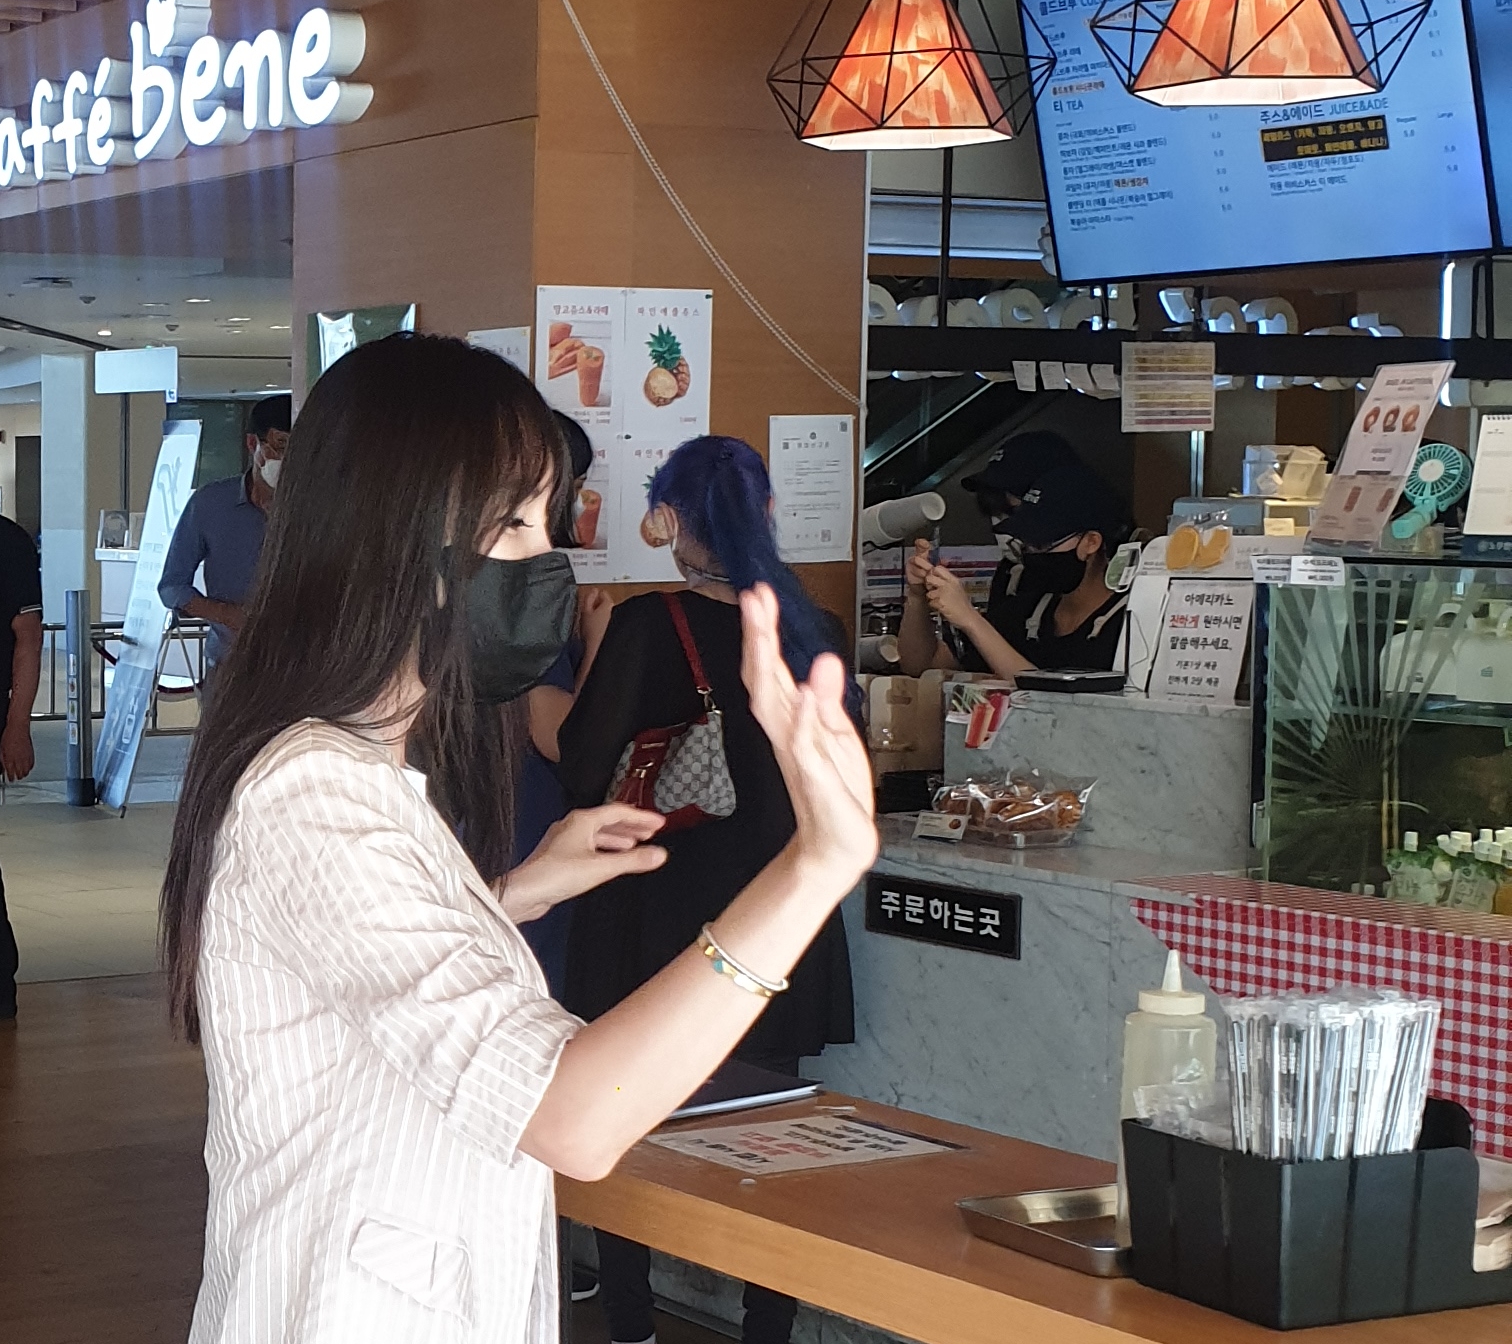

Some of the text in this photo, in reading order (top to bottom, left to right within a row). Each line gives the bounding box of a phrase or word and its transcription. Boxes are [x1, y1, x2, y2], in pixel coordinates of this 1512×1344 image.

[129, 1, 342, 161] bene
[1066, 99, 1084, 111] TEA
[1329, 97, 1389, 116] JUICE&ADE
[1185, 593, 1234, 606] 아메리카노
[1203, 615, 1242, 630] 원하시면
[881, 890, 1001, 938] 주문하는곳
